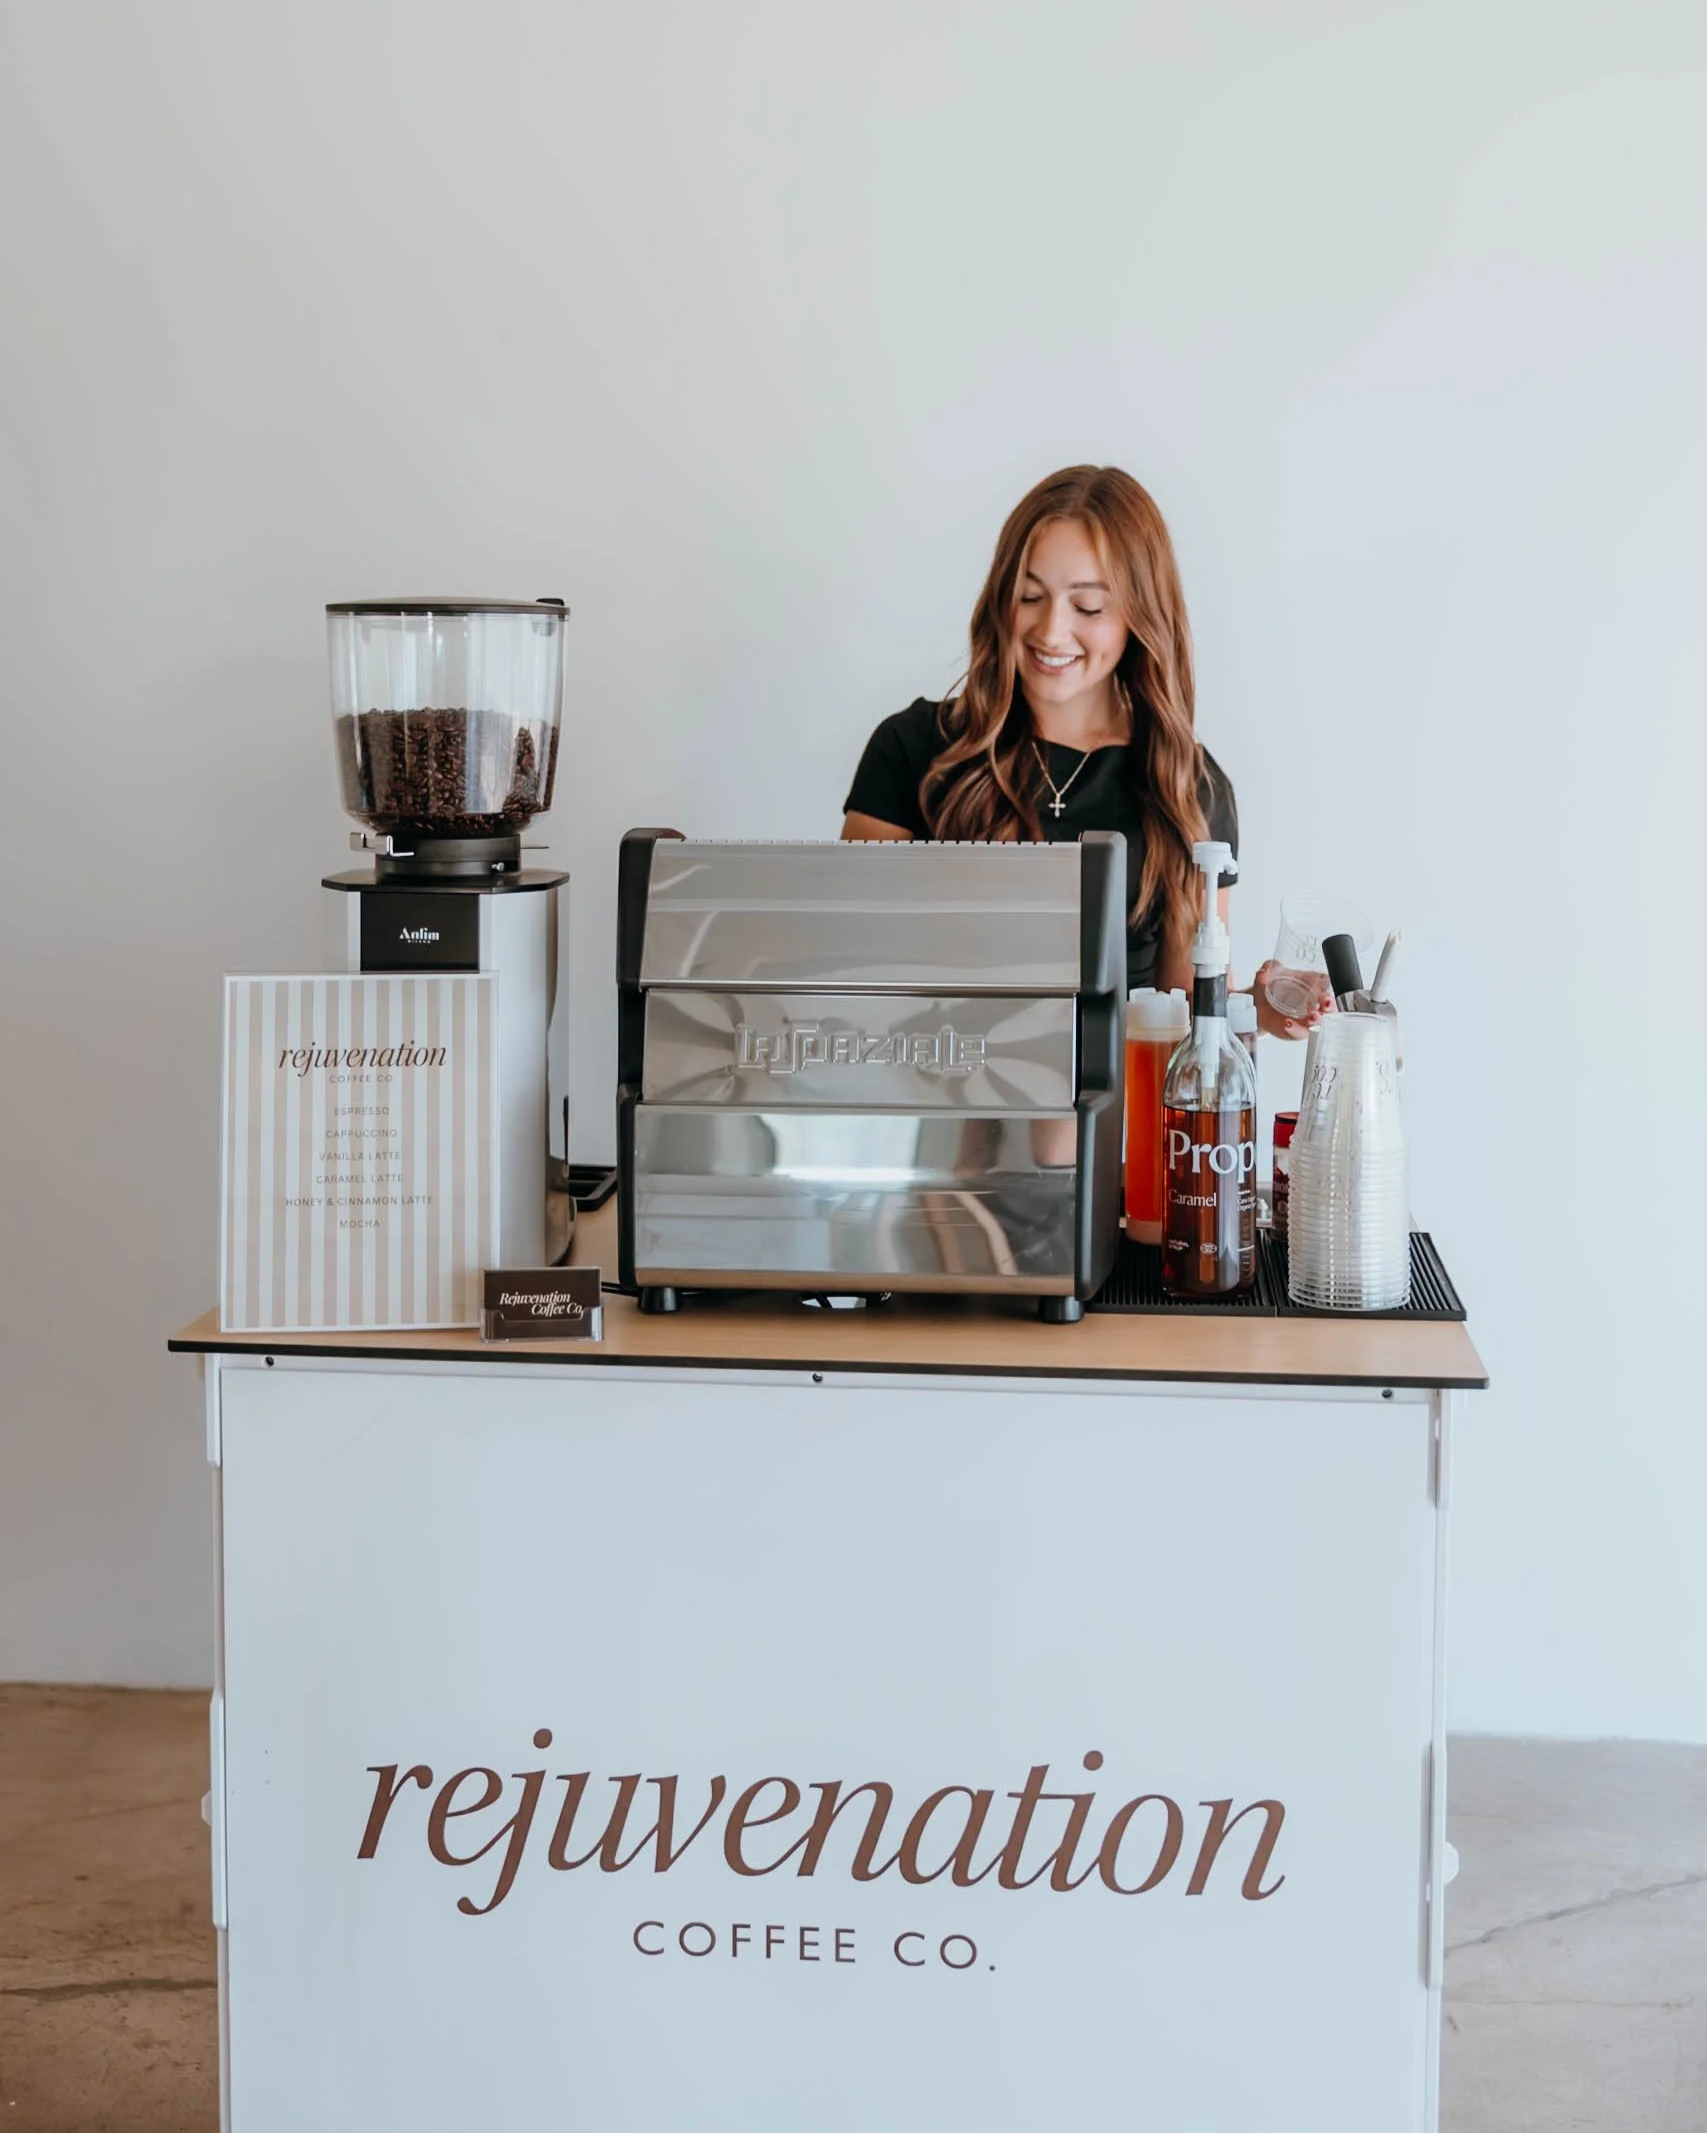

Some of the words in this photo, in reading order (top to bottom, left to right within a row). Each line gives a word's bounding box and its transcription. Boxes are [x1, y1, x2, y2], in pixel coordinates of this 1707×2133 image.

[278, 1040, 448, 1077] rejuvenation
[329, 1074, 373, 1084] COFFEE
[334, 1107, 390, 1116] ESPRESSO
[326, 1129, 398, 1139] CAPPUCCINO
[319, 1152, 364, 1161] VANILLA
[368, 1151, 401, 1161] LATTE
[316, 1174, 367, 1184] CARAMEL
[371, 1174, 404, 1183] LATTE
[285, 1197, 322, 1207] HONEY
[326, 1197, 334, 1206] &
[336, 1197, 398, 1206] CINNAMON
[401, 1196, 433, 1206] LATTE
[1168, 1189, 1217, 1207] Caramel
[339, 1219, 381, 1229] MOCHA
[500, 1291, 571, 1306] Rejuvenation
[531, 1302, 566, 1317] Coffee
[356, 1728, 1287, 1916] rejuvenation
[633, 1920, 856, 1963] COFFEE
[893, 1931, 996, 1972] CO.
